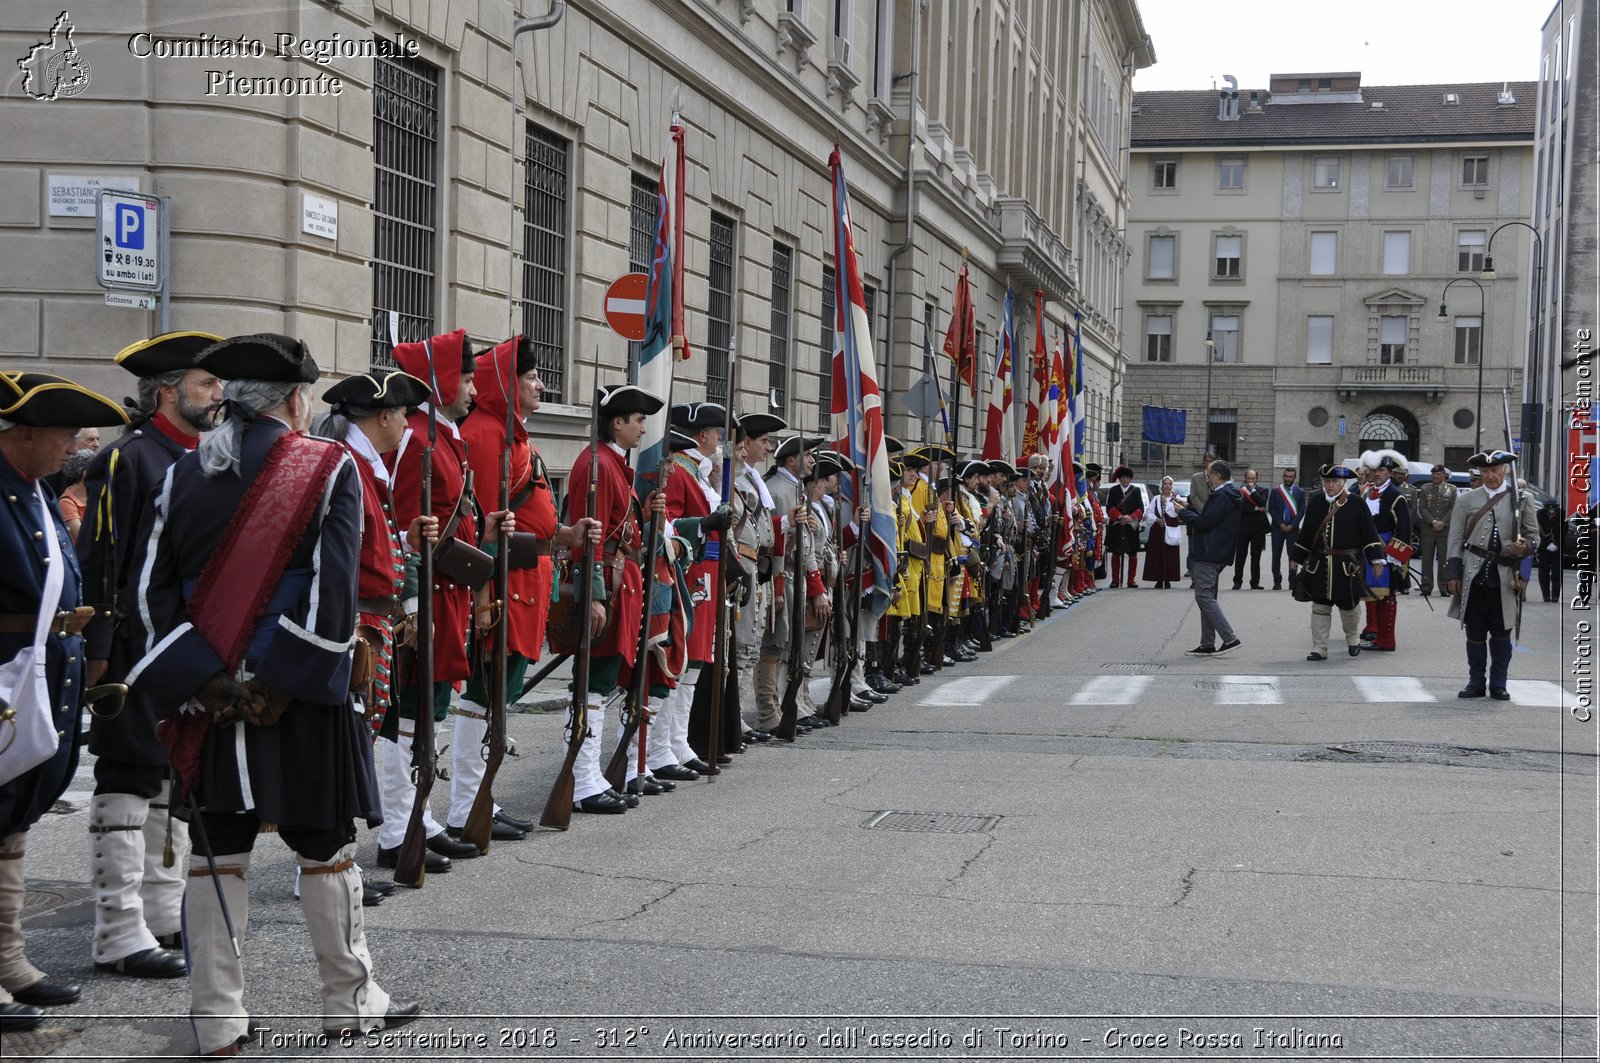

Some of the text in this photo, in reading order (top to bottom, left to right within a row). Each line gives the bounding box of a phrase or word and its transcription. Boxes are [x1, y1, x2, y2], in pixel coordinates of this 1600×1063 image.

[121, 208, 140, 243] P
[106, 269, 115, 277] su
[116, 269, 136, 279] ambo
[141, 271, 154, 281] lati
[106, 295, 148, 309] Sottozona A2
